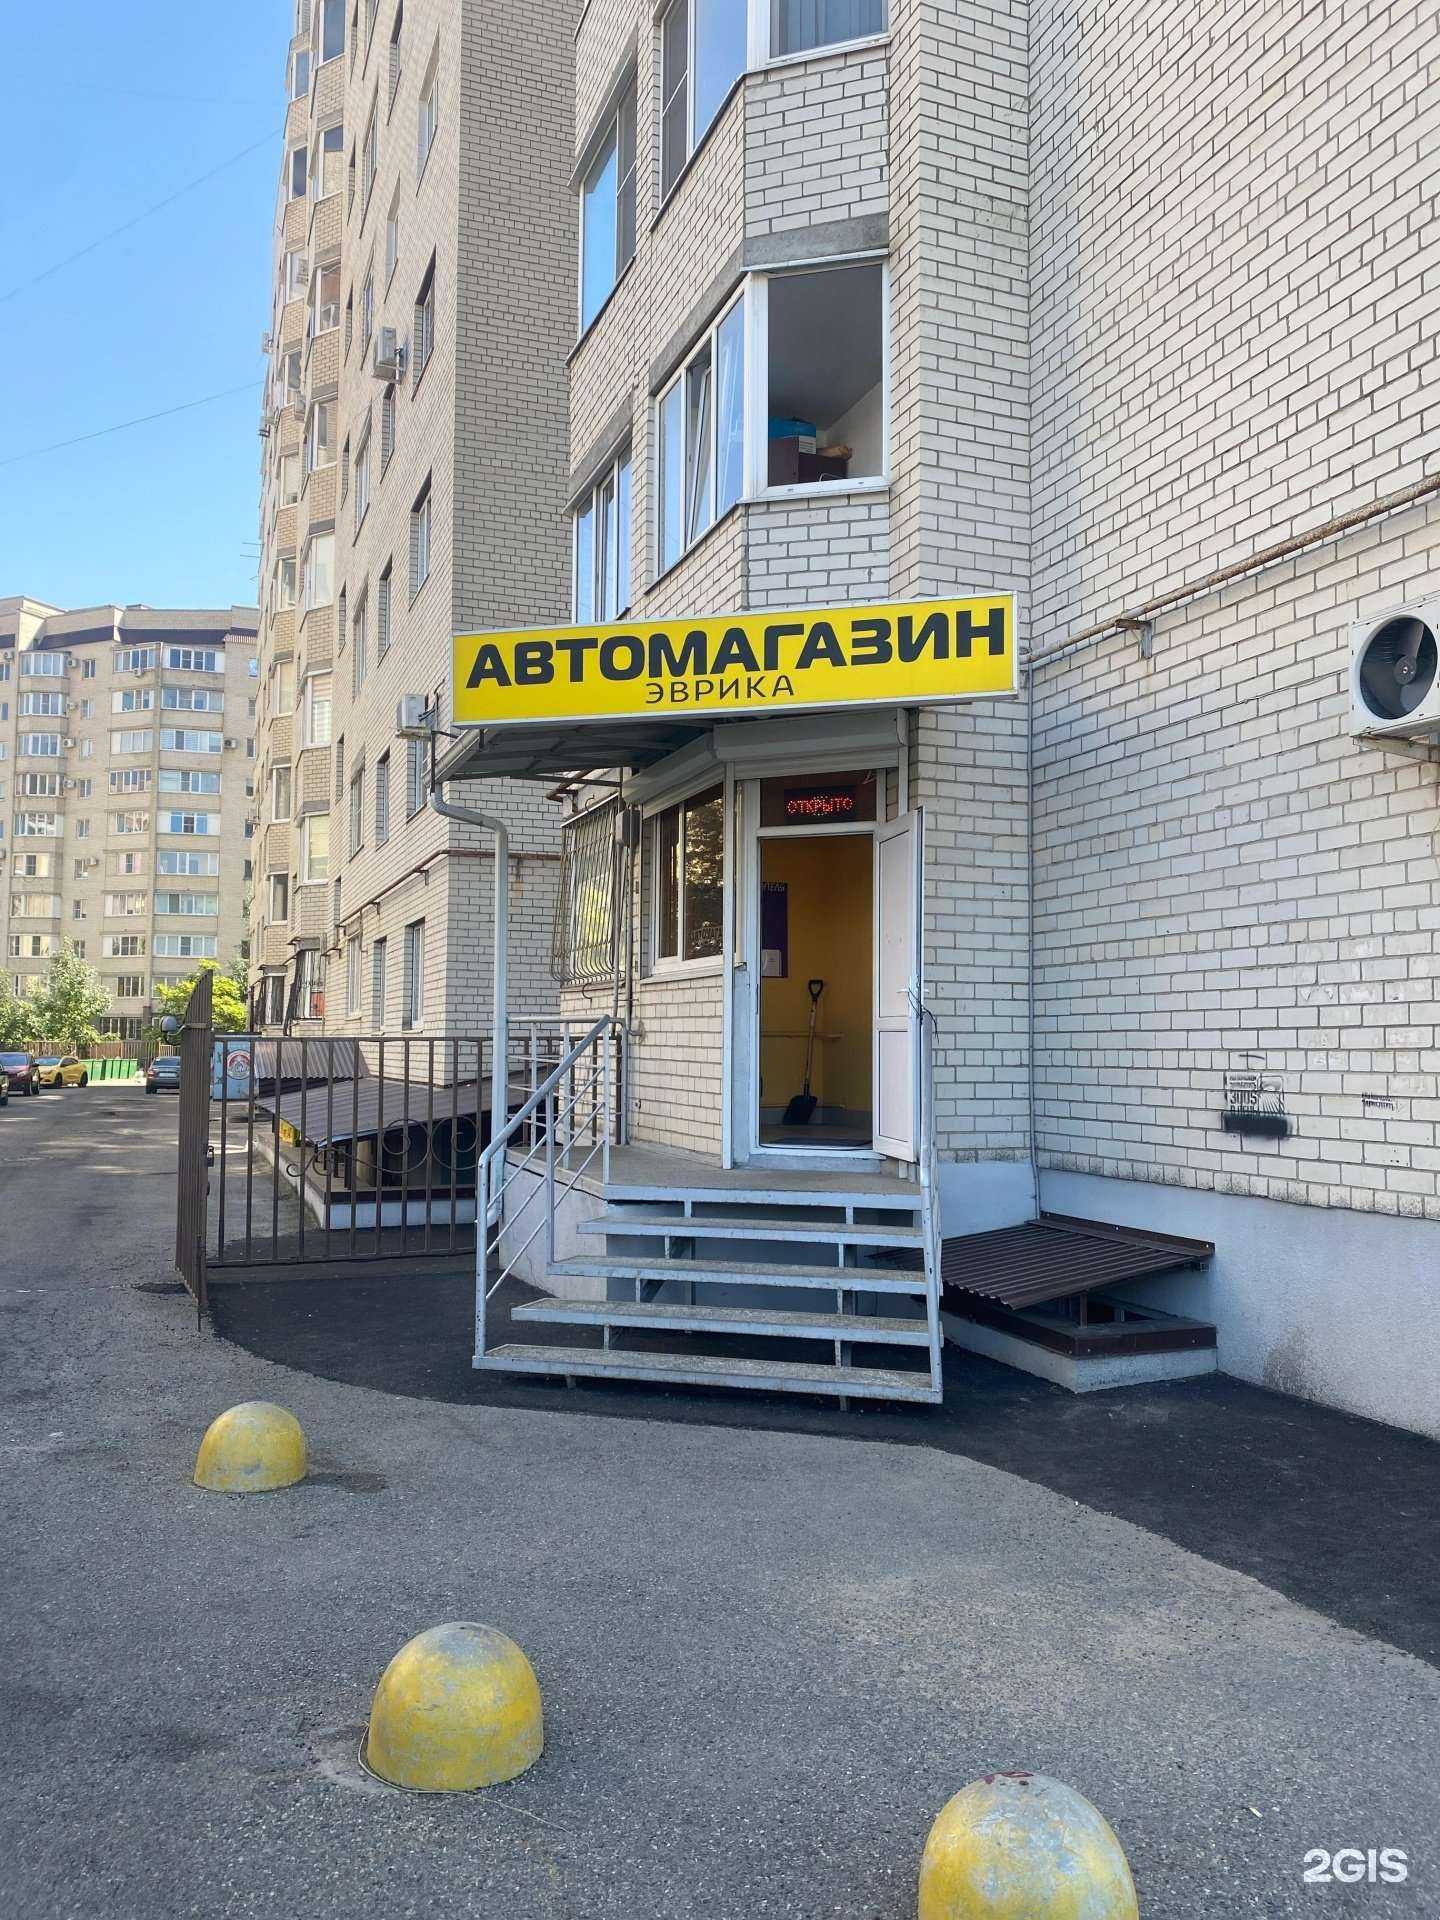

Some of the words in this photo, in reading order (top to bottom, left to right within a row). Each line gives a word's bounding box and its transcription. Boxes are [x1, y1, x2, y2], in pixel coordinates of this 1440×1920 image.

[466, 607, 1005, 689] АВТОМАГАЗИН
[645, 675, 794, 704] ЭВРИКА
[787, 796, 854, 814] ОТКРЫТО
